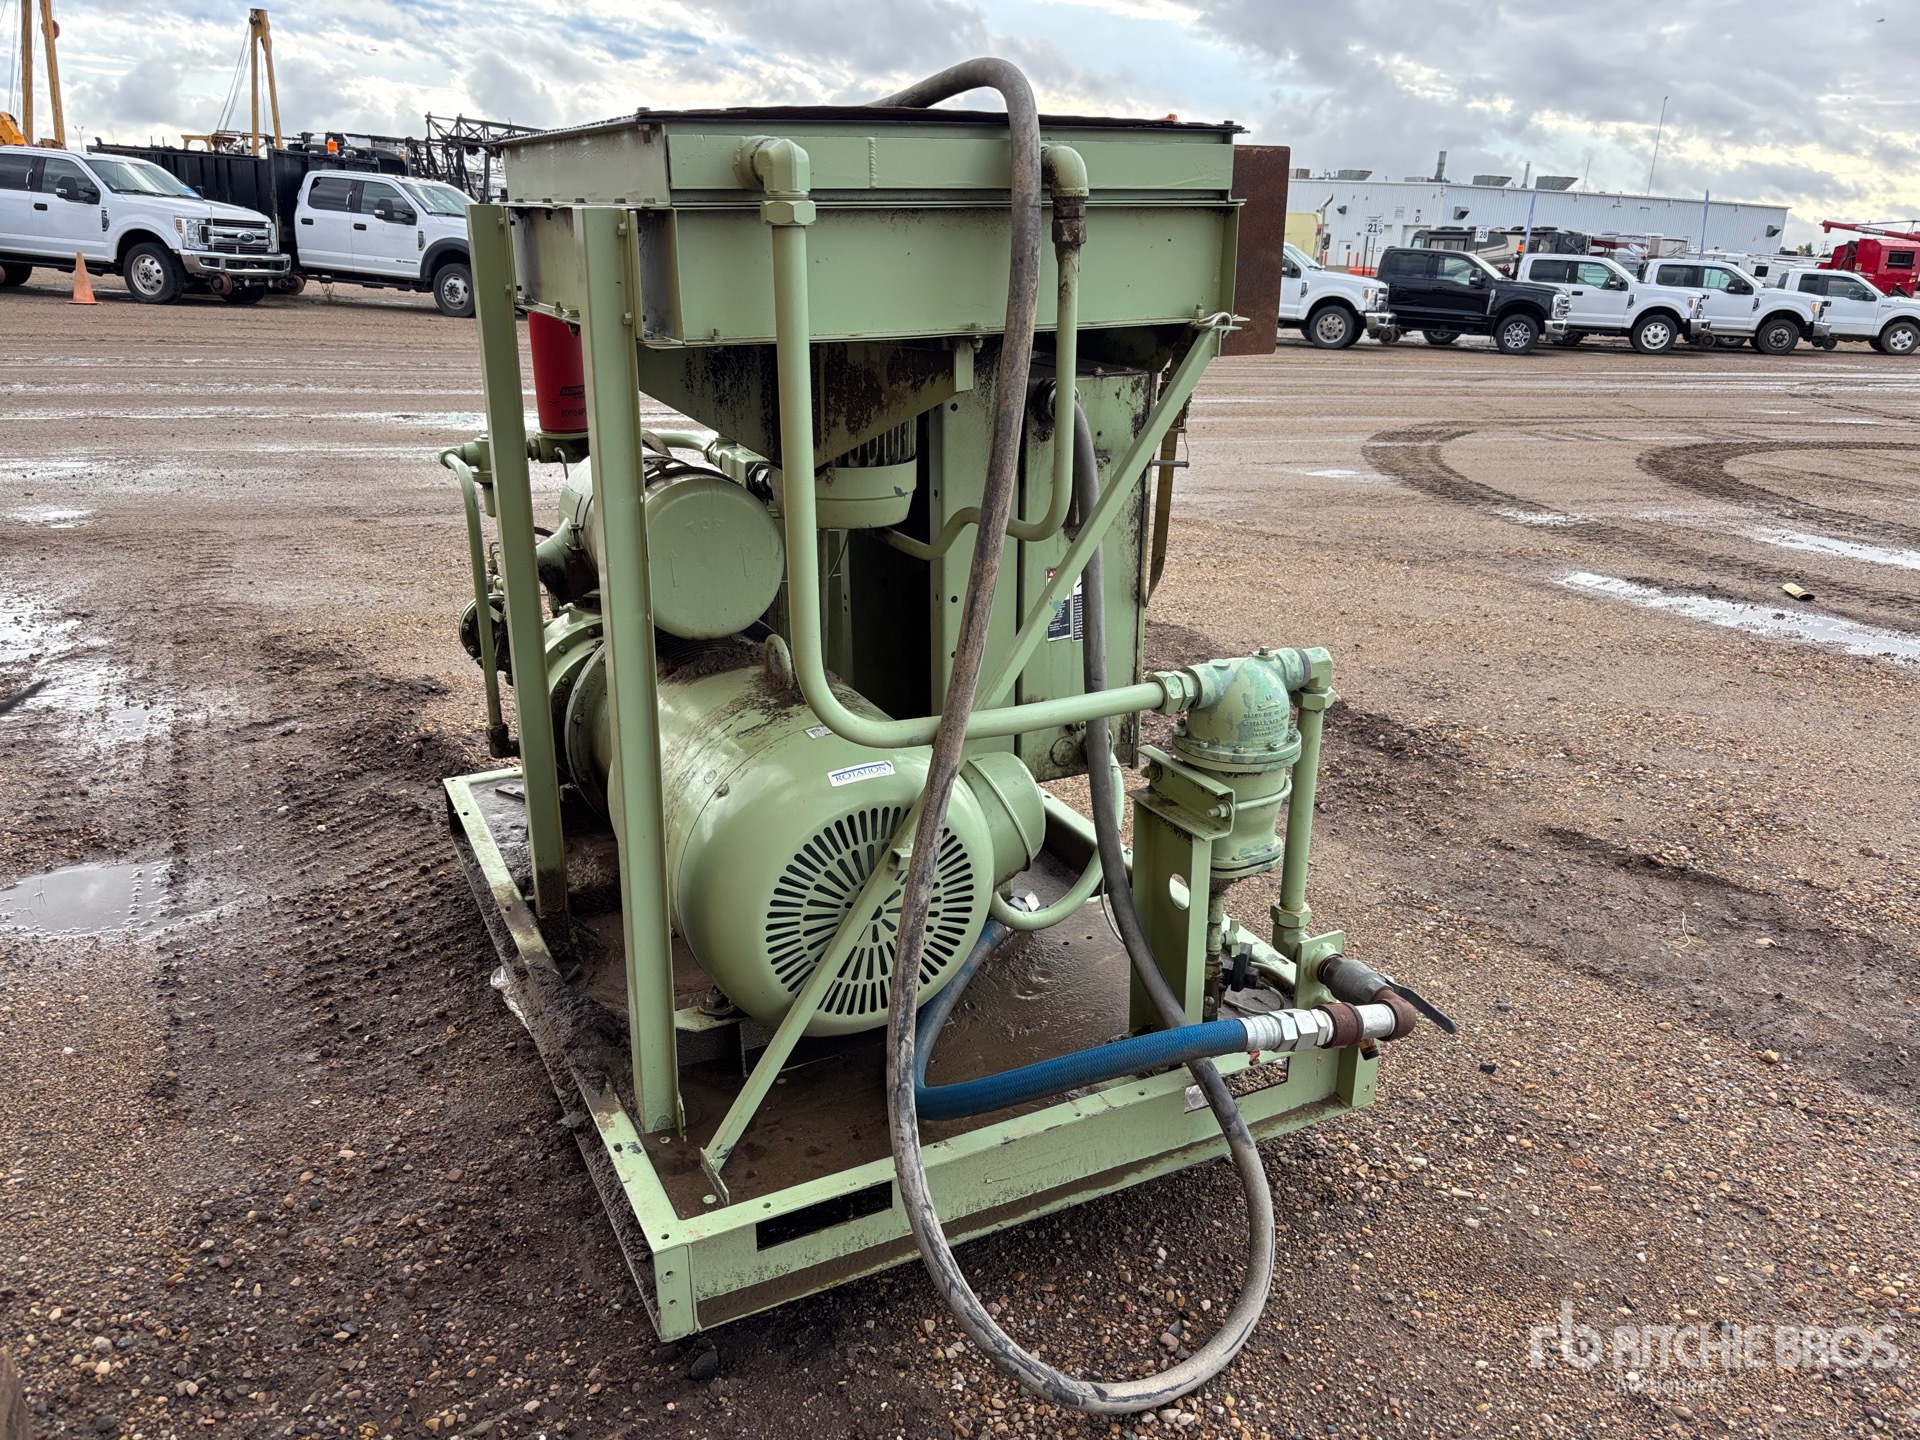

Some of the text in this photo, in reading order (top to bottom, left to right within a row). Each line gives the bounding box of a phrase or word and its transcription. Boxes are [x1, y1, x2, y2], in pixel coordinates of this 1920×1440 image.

[1368, 224, 1378, 232] 21
[1478, 230, 1488, 239] 28
[835, 766, 887, 782] ROTATION
